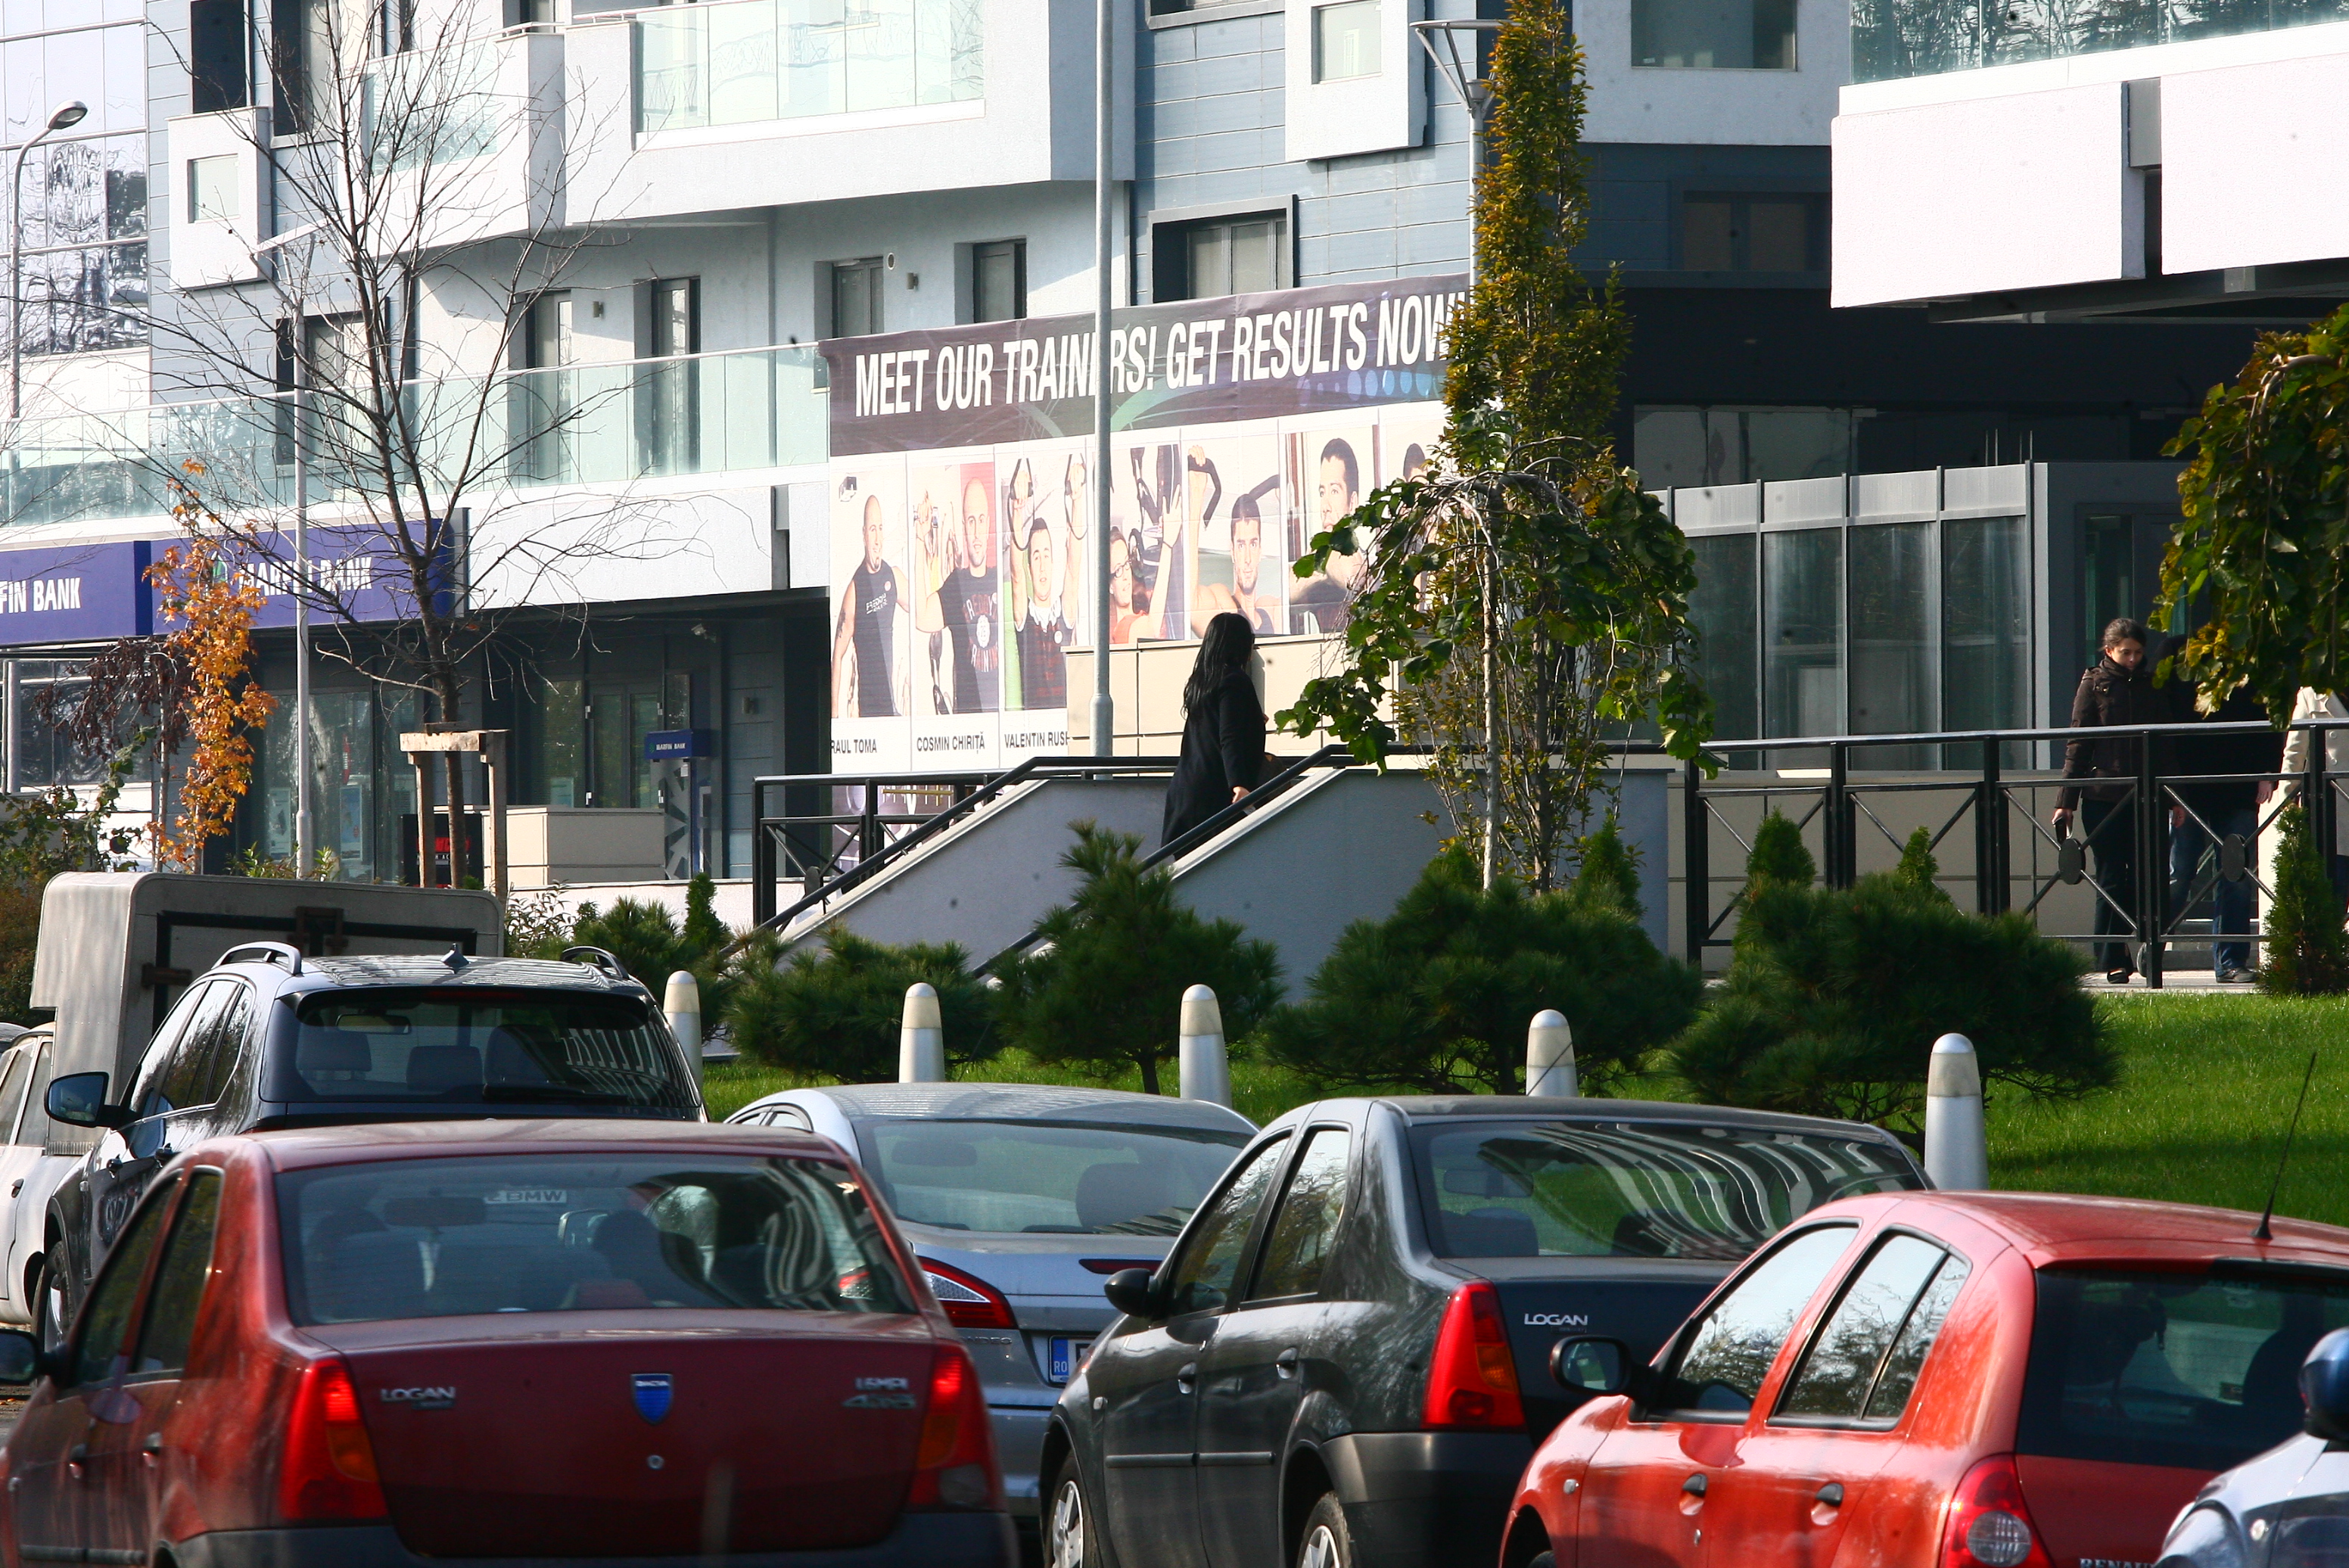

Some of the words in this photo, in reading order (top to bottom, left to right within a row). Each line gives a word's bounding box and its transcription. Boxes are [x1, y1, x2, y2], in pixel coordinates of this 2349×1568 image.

[855, 349, 930, 417] MEET
[935, 343, 994, 412] OUR
[1166, 319, 1226, 390] GET
[1231, 301, 1368, 383] RESULTS
[320, 556, 372, 593] BANK
[33, 577, 81, 611] BANK
[853, 739, 877, 754] TOMA
[916, 736, 950, 752] COSMIN
[1004, 732, 1045, 748] VALENTIN
[1524, 1313, 1588, 1326] LOGAN
[1053, 1361, 1068, 1372] RO
[381, 1386, 456, 1402] LOGAN
